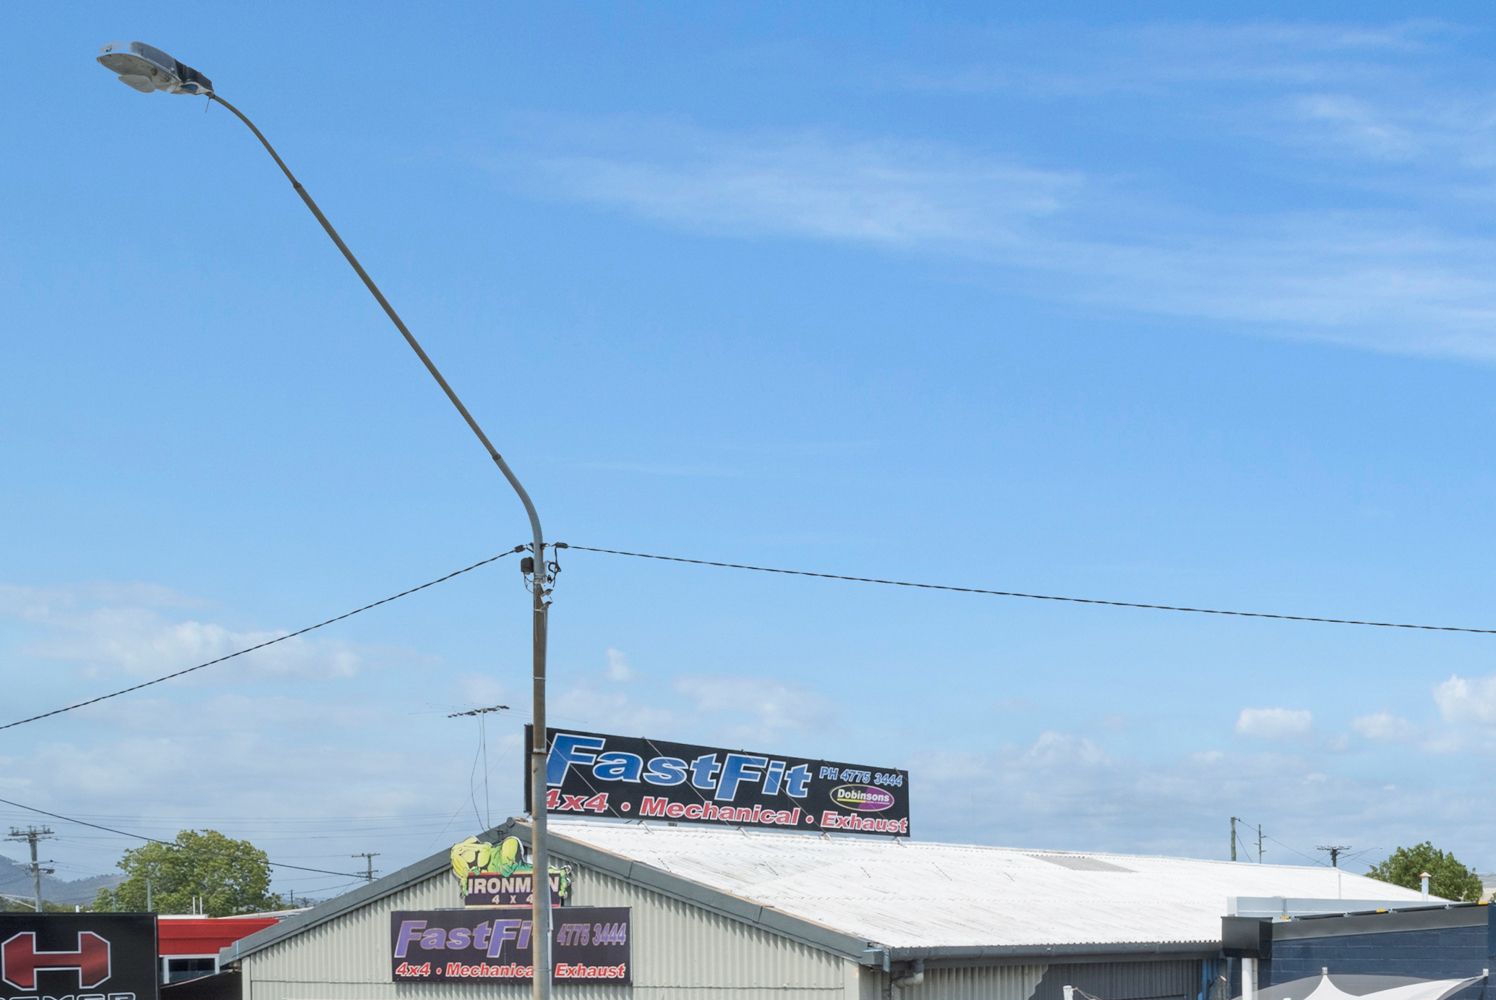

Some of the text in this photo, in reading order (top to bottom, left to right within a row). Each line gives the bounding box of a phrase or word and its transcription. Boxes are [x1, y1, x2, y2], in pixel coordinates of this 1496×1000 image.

[546, 733, 903, 801] FastFit PH 4775 3444
[837, 788, 890, 803] Dobinsons
[546, 788, 908, 834] 4x4 Mechanical Exhaust
[467, 876, 560, 894] IRONMN
[491, 895, 500, 904] 4
[394, 919, 533, 958] FastFi
[556, 922, 627, 947] 4775 3444
[395, 962, 626, 978] 4x4 Mechanica Exhaust
